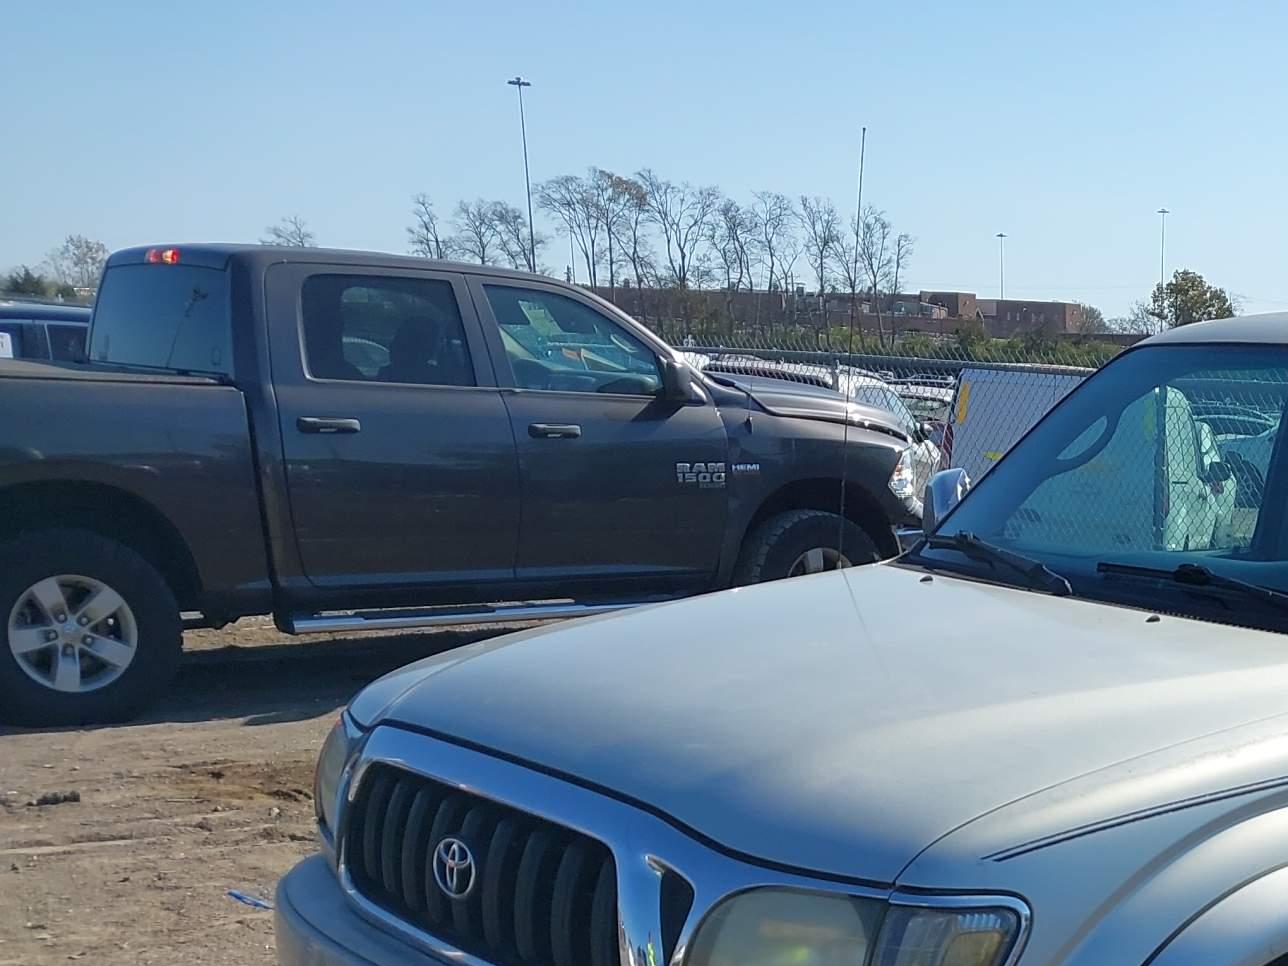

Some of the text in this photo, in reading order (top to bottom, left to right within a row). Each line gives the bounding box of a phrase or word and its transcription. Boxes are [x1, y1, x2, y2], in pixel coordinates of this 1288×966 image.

[676, 462, 726, 473] RAM
[731, 463, 760, 472] HEMI
[676, 472, 726, 482] 1500
